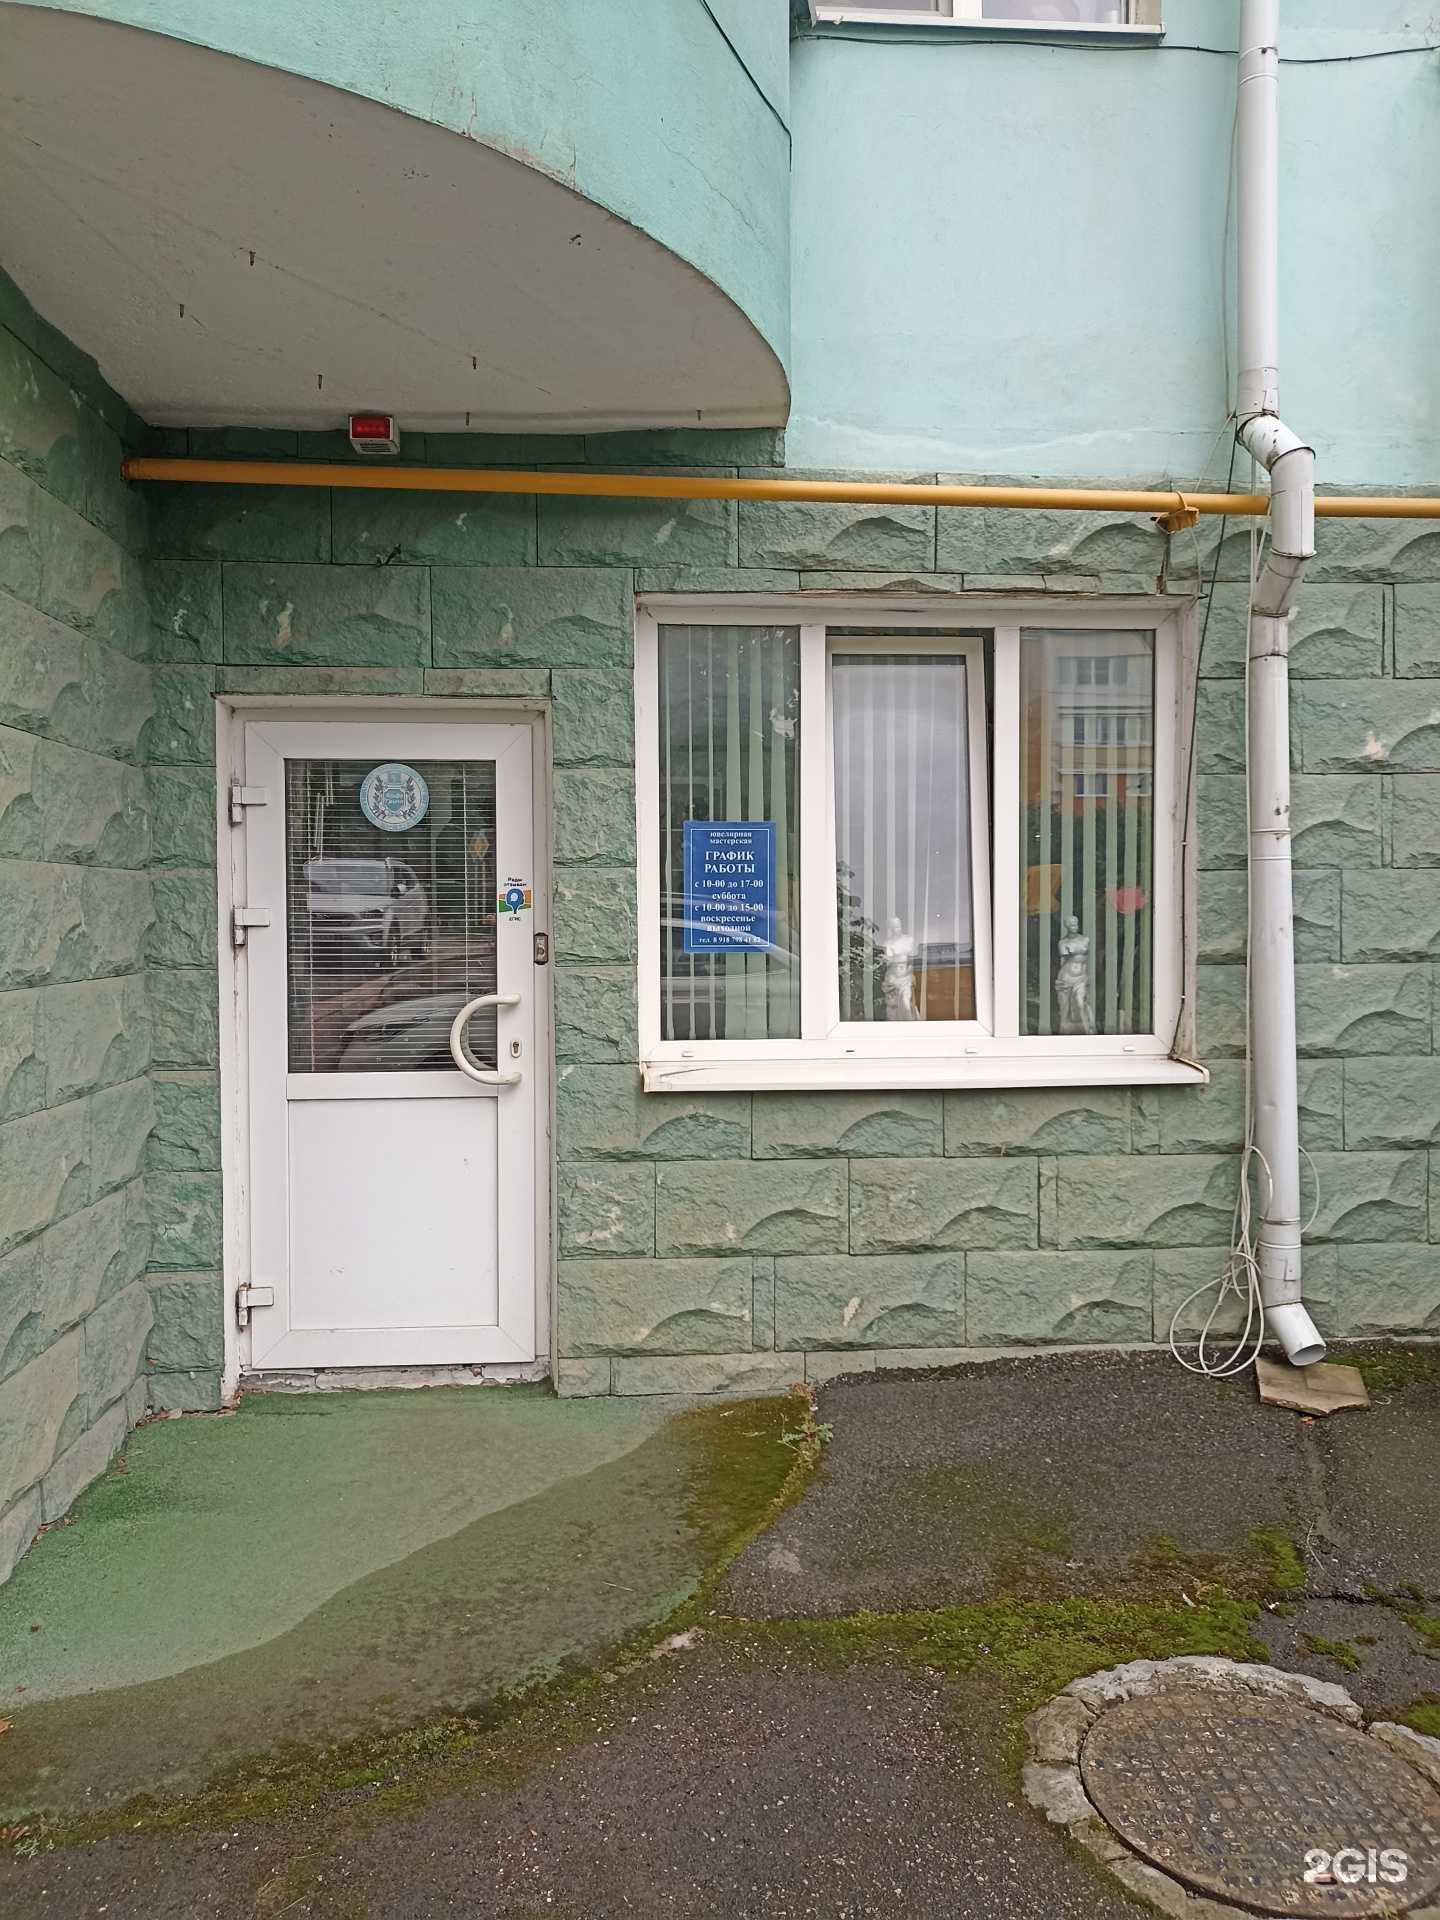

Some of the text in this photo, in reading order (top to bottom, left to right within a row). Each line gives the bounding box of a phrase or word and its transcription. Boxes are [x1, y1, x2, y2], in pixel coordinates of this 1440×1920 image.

[710, 831, 752, 839] ювелирная
[705, 851, 755, 861] ГРАФИК
[704, 863, 755, 873] РАБОТЫ
[703, 879, 726, 888] 10-00
[727, 881, 738, 889] до
[741, 879, 764, 888] 17-00
[712, 891, 746, 901] суббота
[703, 903, 726, 912] 10-00
[741, 903, 764, 912] 15-00
[700, 915, 756, 924] воскресенье
[706, 924, 751, 932] выходной
